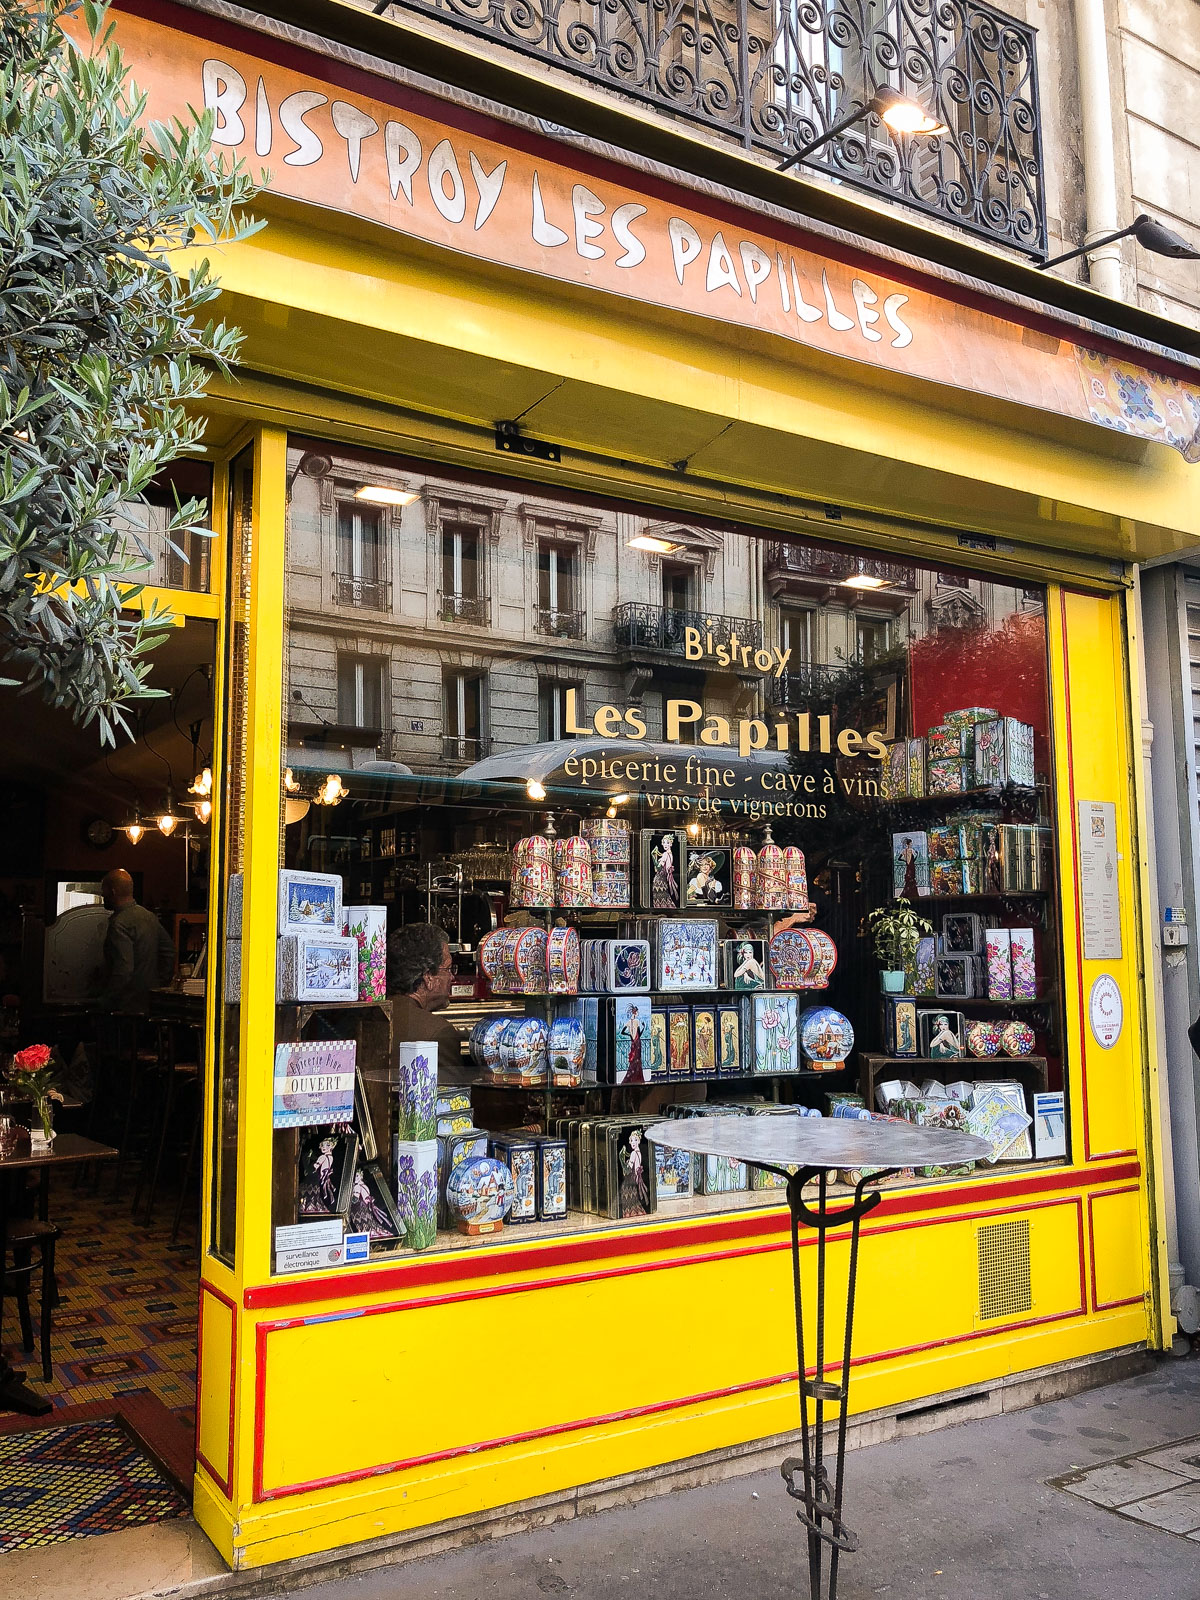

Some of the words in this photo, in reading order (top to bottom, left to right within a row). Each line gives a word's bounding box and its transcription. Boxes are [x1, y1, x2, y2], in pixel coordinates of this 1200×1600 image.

[202, 58, 508, 231] BISTROY
[531, 169, 648, 268] LES
[668, 217, 913, 348] PAPILLES
[685, 620, 792, 677] Bistroy
[565, 688, 647, 740] Les
[666, 699, 888, 759] Papilles
[563, 749, 677, 785] épicerie
[685, 755, 736, 787] fine
[760, 771, 816, 793] cave
[823, 769, 836, 795] à
[841, 771, 889, 798] vins
[645, 788, 690, 812] vins
[697, 787, 722, 813] de
[729, 793, 827, 821] vignerons
[291, 1076, 341, 1093] OUVERT
[283, 1259, 320, 1269] électronique
[285, 1251, 319, 1260] surveillance
